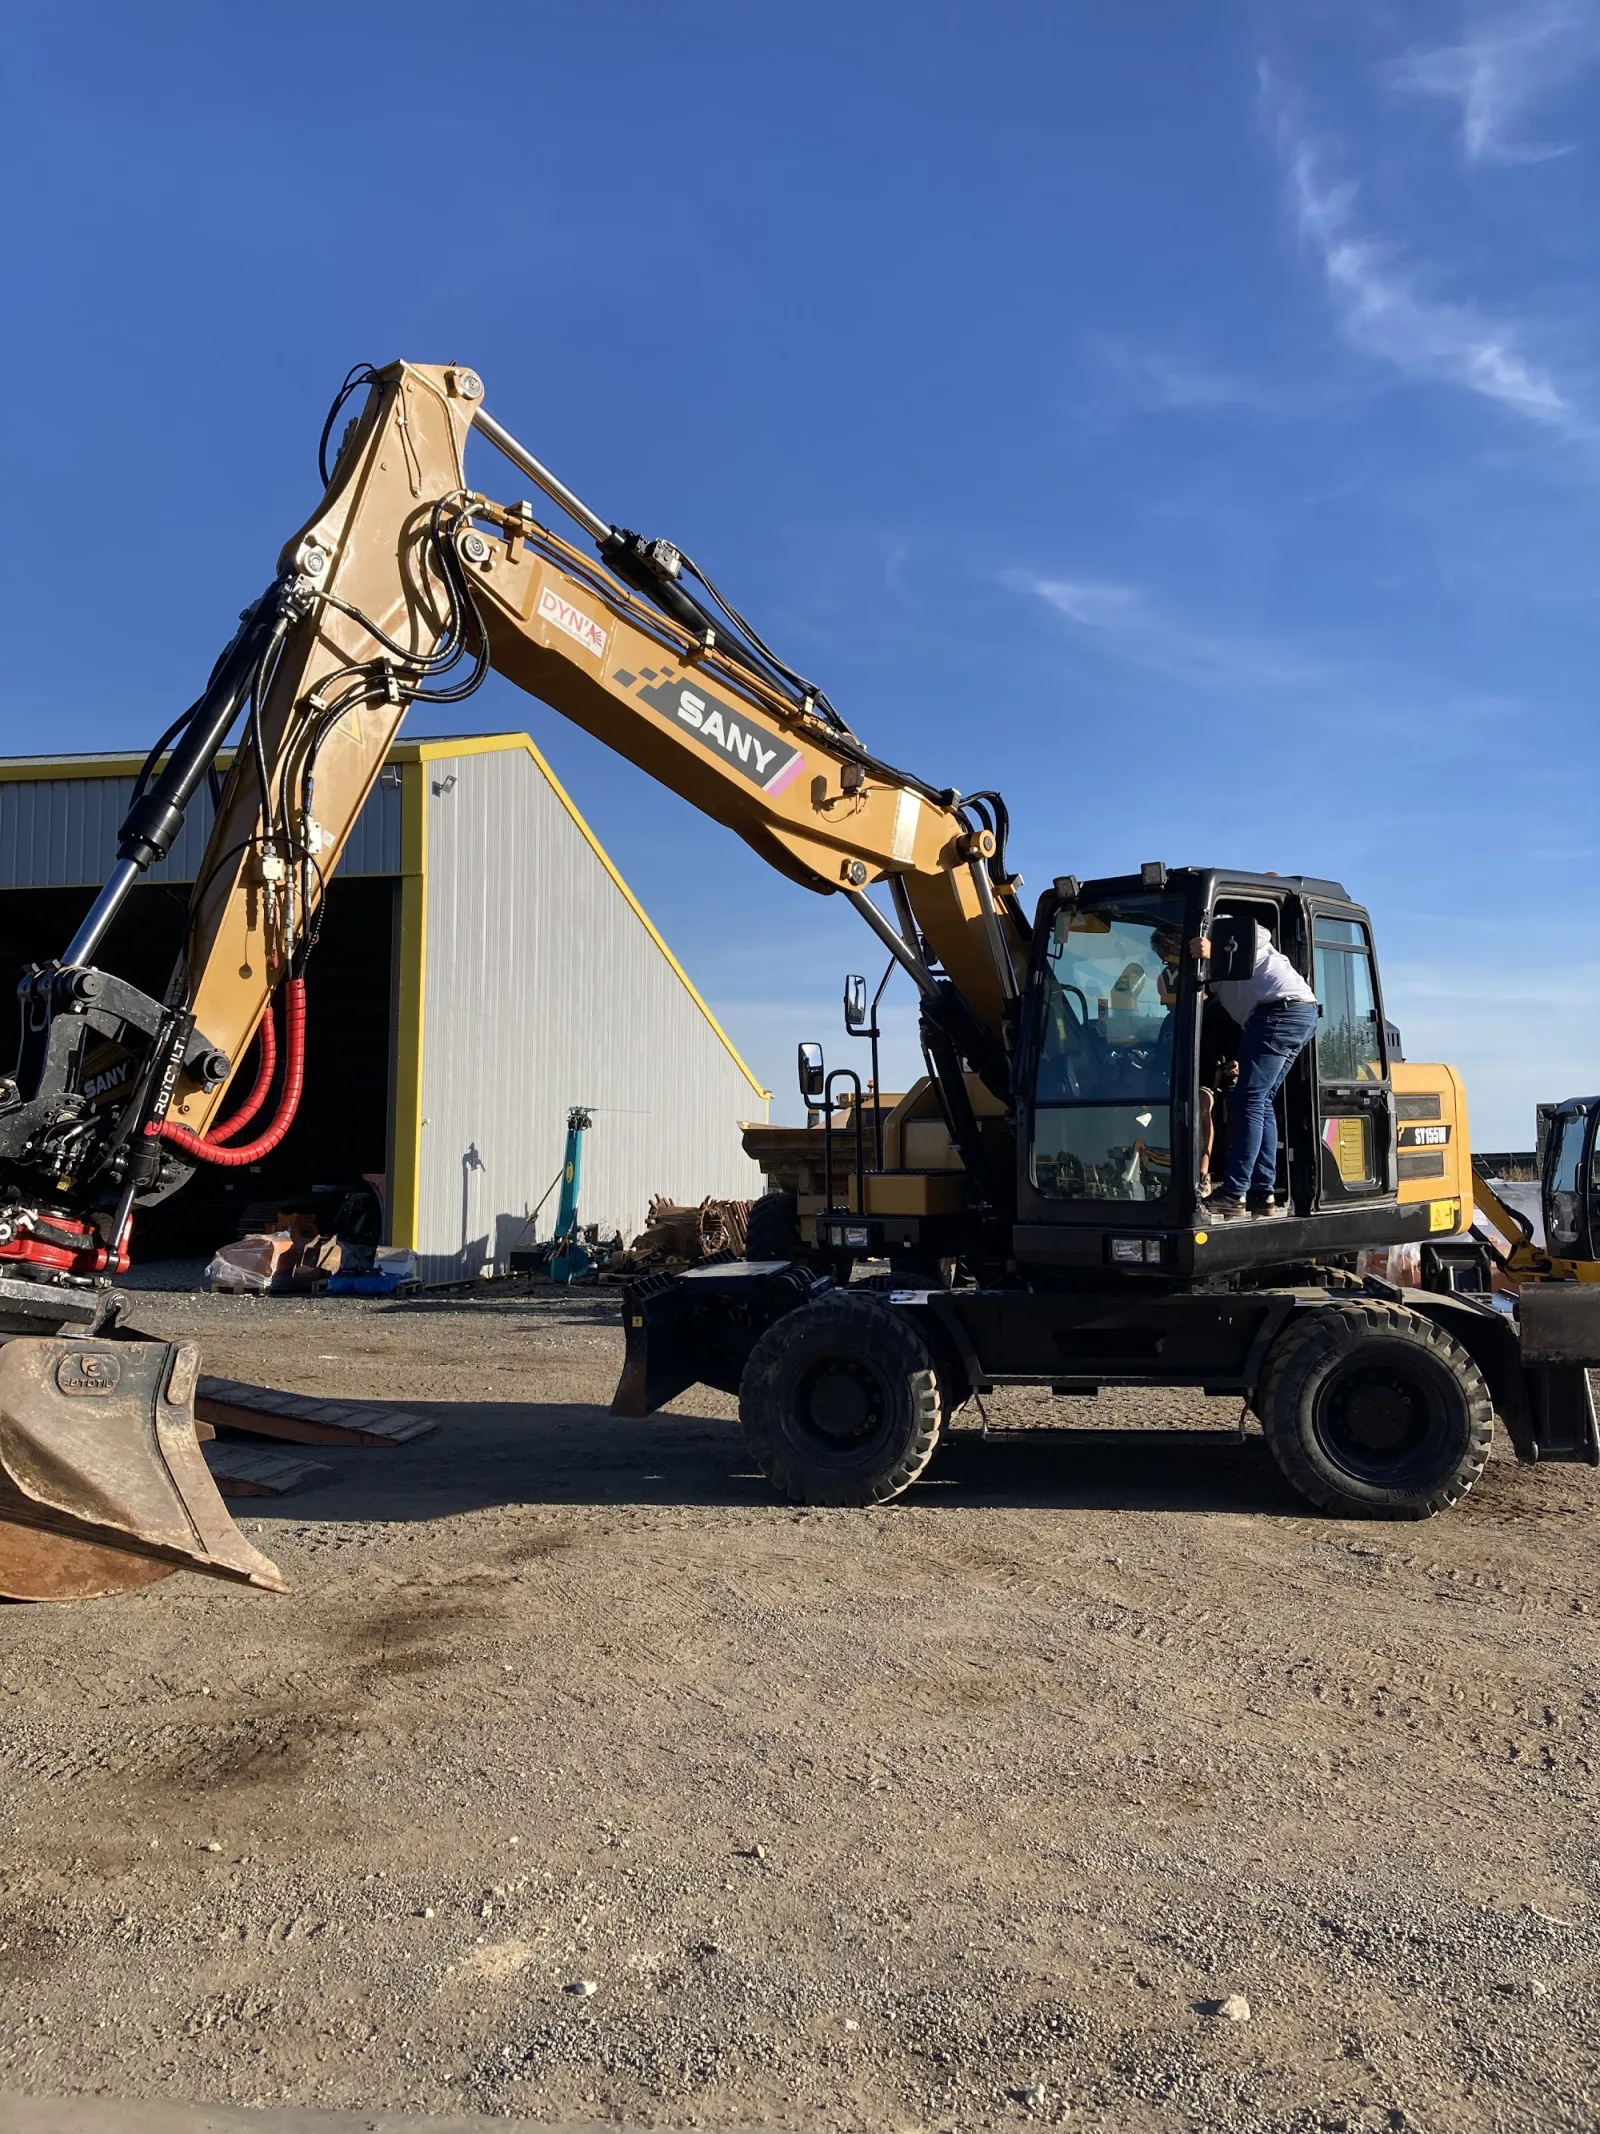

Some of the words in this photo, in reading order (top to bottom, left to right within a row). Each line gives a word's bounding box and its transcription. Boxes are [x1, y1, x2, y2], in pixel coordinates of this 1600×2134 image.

[677, 690, 777, 774] SANY
[83, 1062, 127, 1099] SANY
[1414, 1126, 1447, 1145] SY155W
